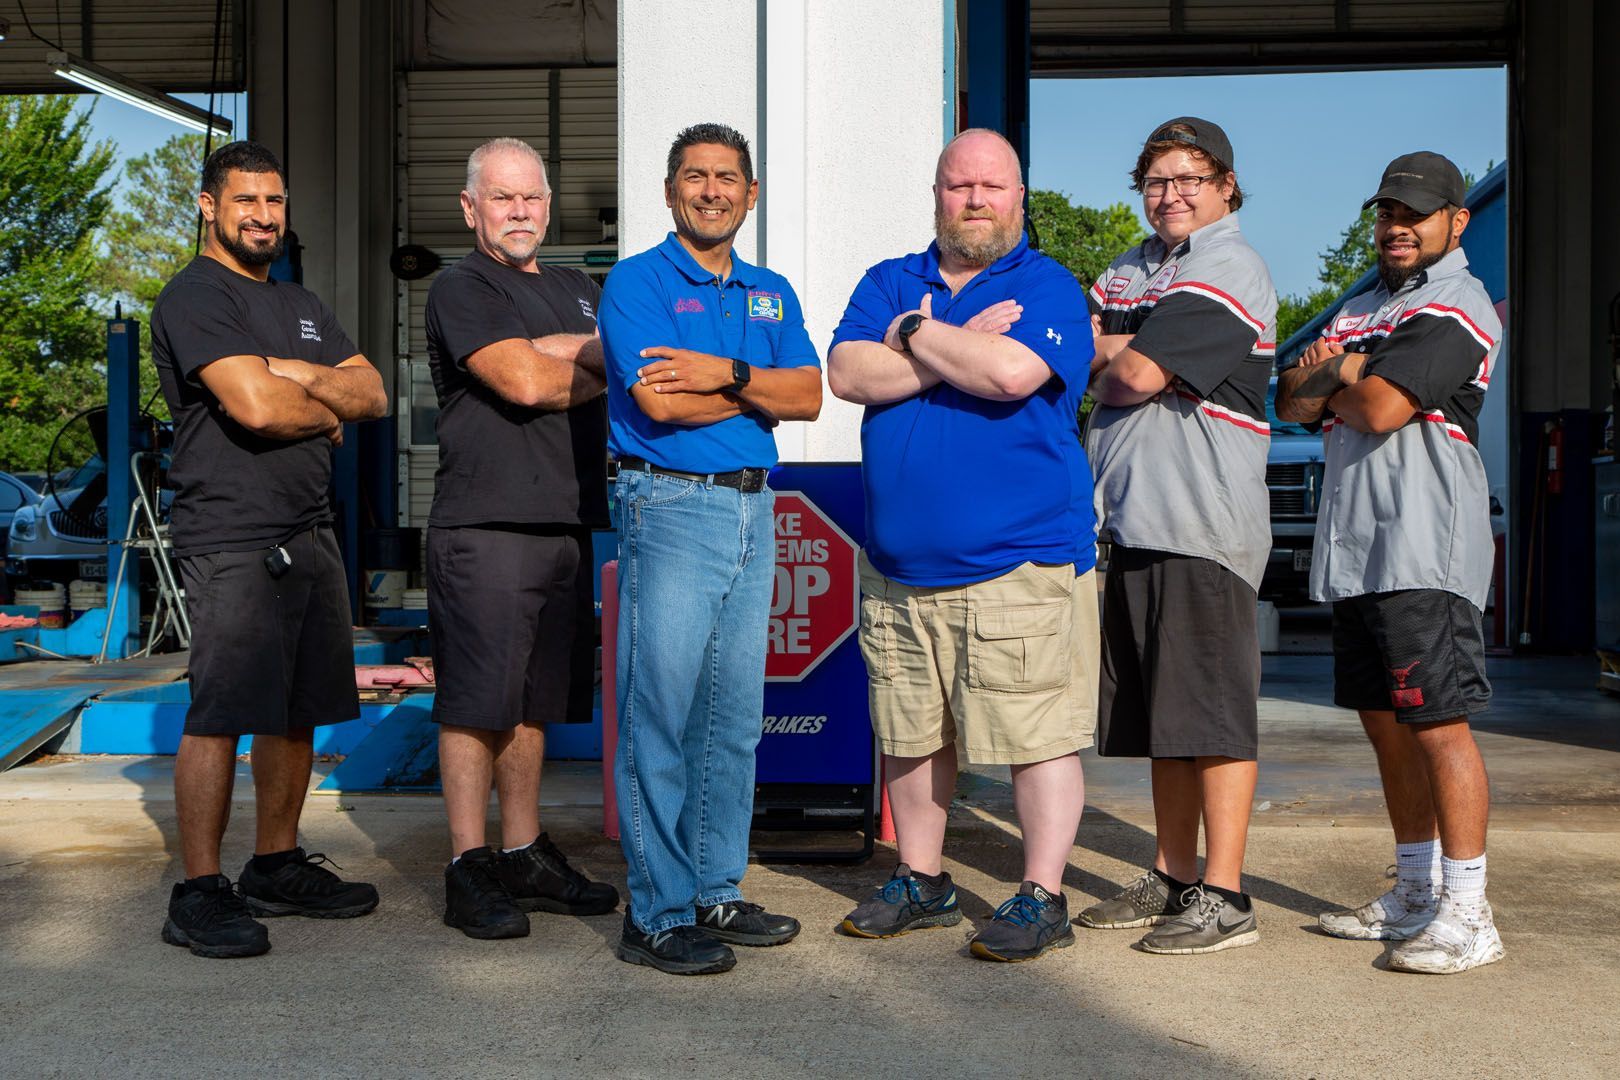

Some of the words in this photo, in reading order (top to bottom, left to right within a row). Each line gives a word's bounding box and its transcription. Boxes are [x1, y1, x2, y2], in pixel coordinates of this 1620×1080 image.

[769, 565, 831, 616] OP
[767, 618, 811, 654] RE
[762, 716, 827, 734] RAKES
